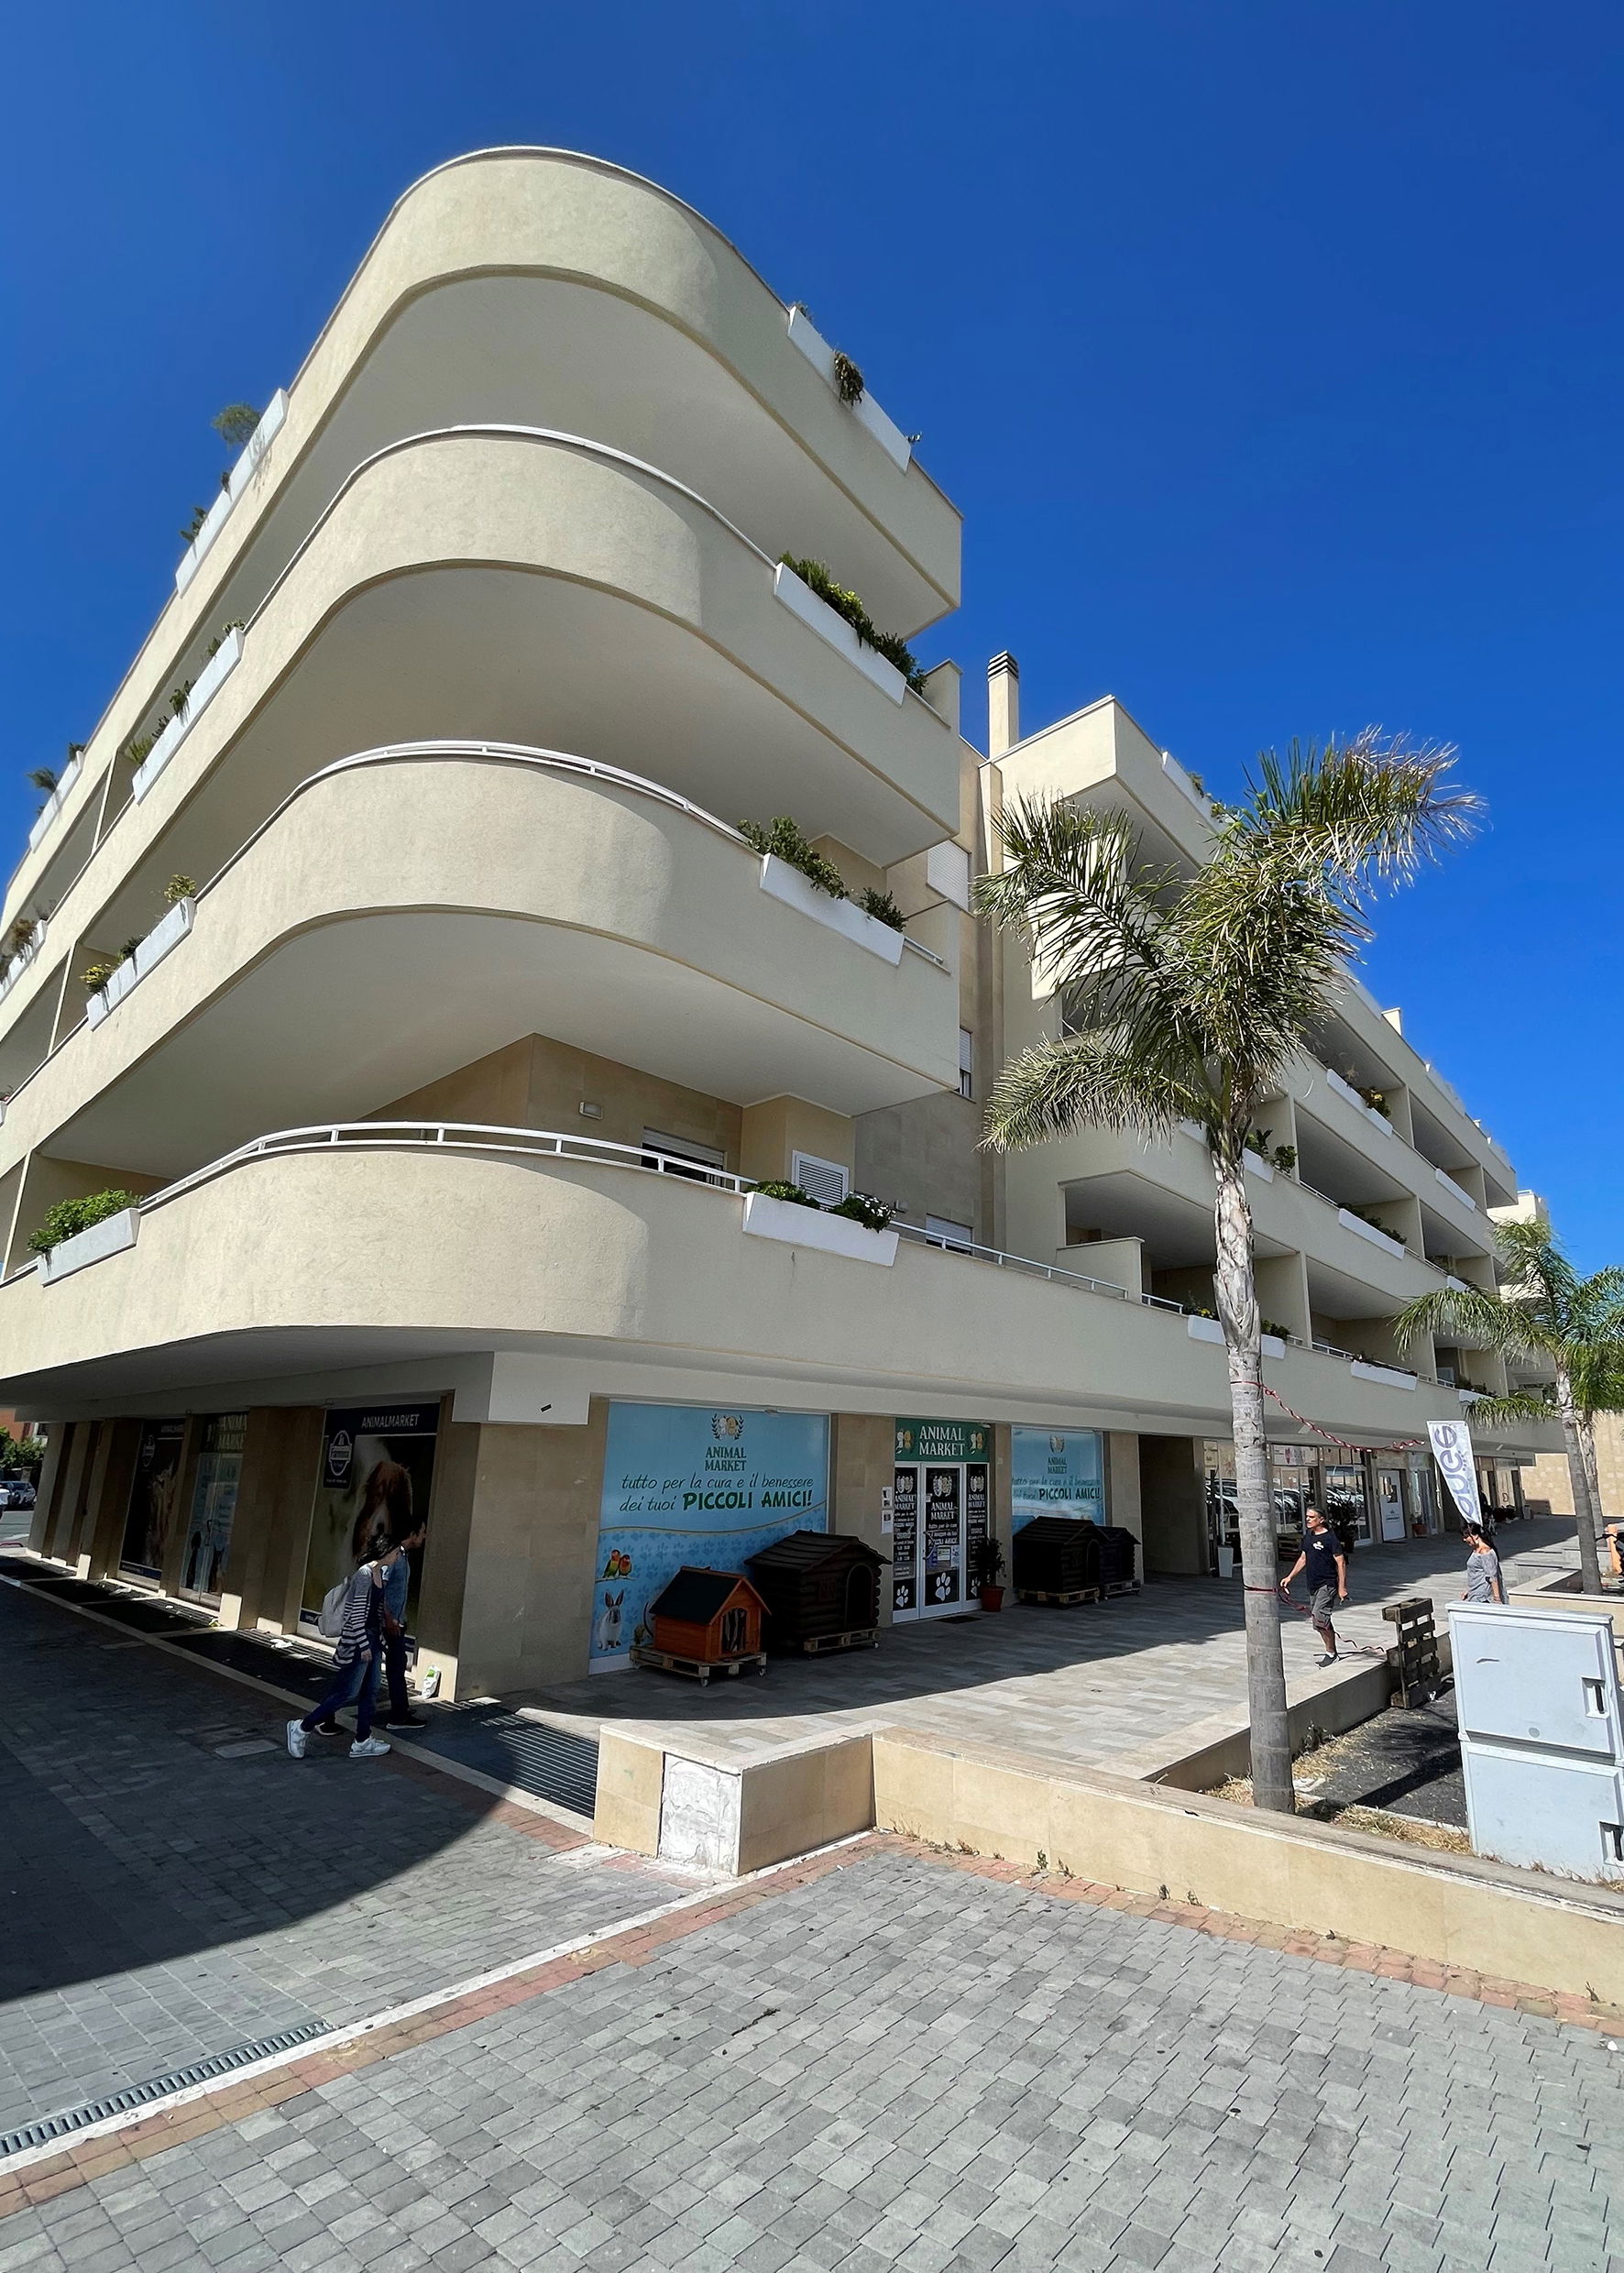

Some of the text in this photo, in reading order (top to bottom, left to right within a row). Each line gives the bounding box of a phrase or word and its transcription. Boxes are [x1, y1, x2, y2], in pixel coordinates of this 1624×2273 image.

[361, 1413, 420, 1428] ANIMALMARKET
[919, 1425, 965, 1442] ANIMAL
[705, 1445, 747, 1459] ANIMAL
[919, 1442, 965, 1456] MARKET
[704, 1459, 747, 1472] MARKET
[1048, 1456, 1067, 1465] ANIMAL
[621, 1472, 814, 1494] tutto per la cura e il benessere
[620, 1489, 813, 1511] dei tuoi PICCOLI AMICI!
[1039, 1488, 1072, 1500] PICCOLI
[931, 1501, 954, 1511] ANIMAL
[930, 1510, 955, 1521] MARKET
